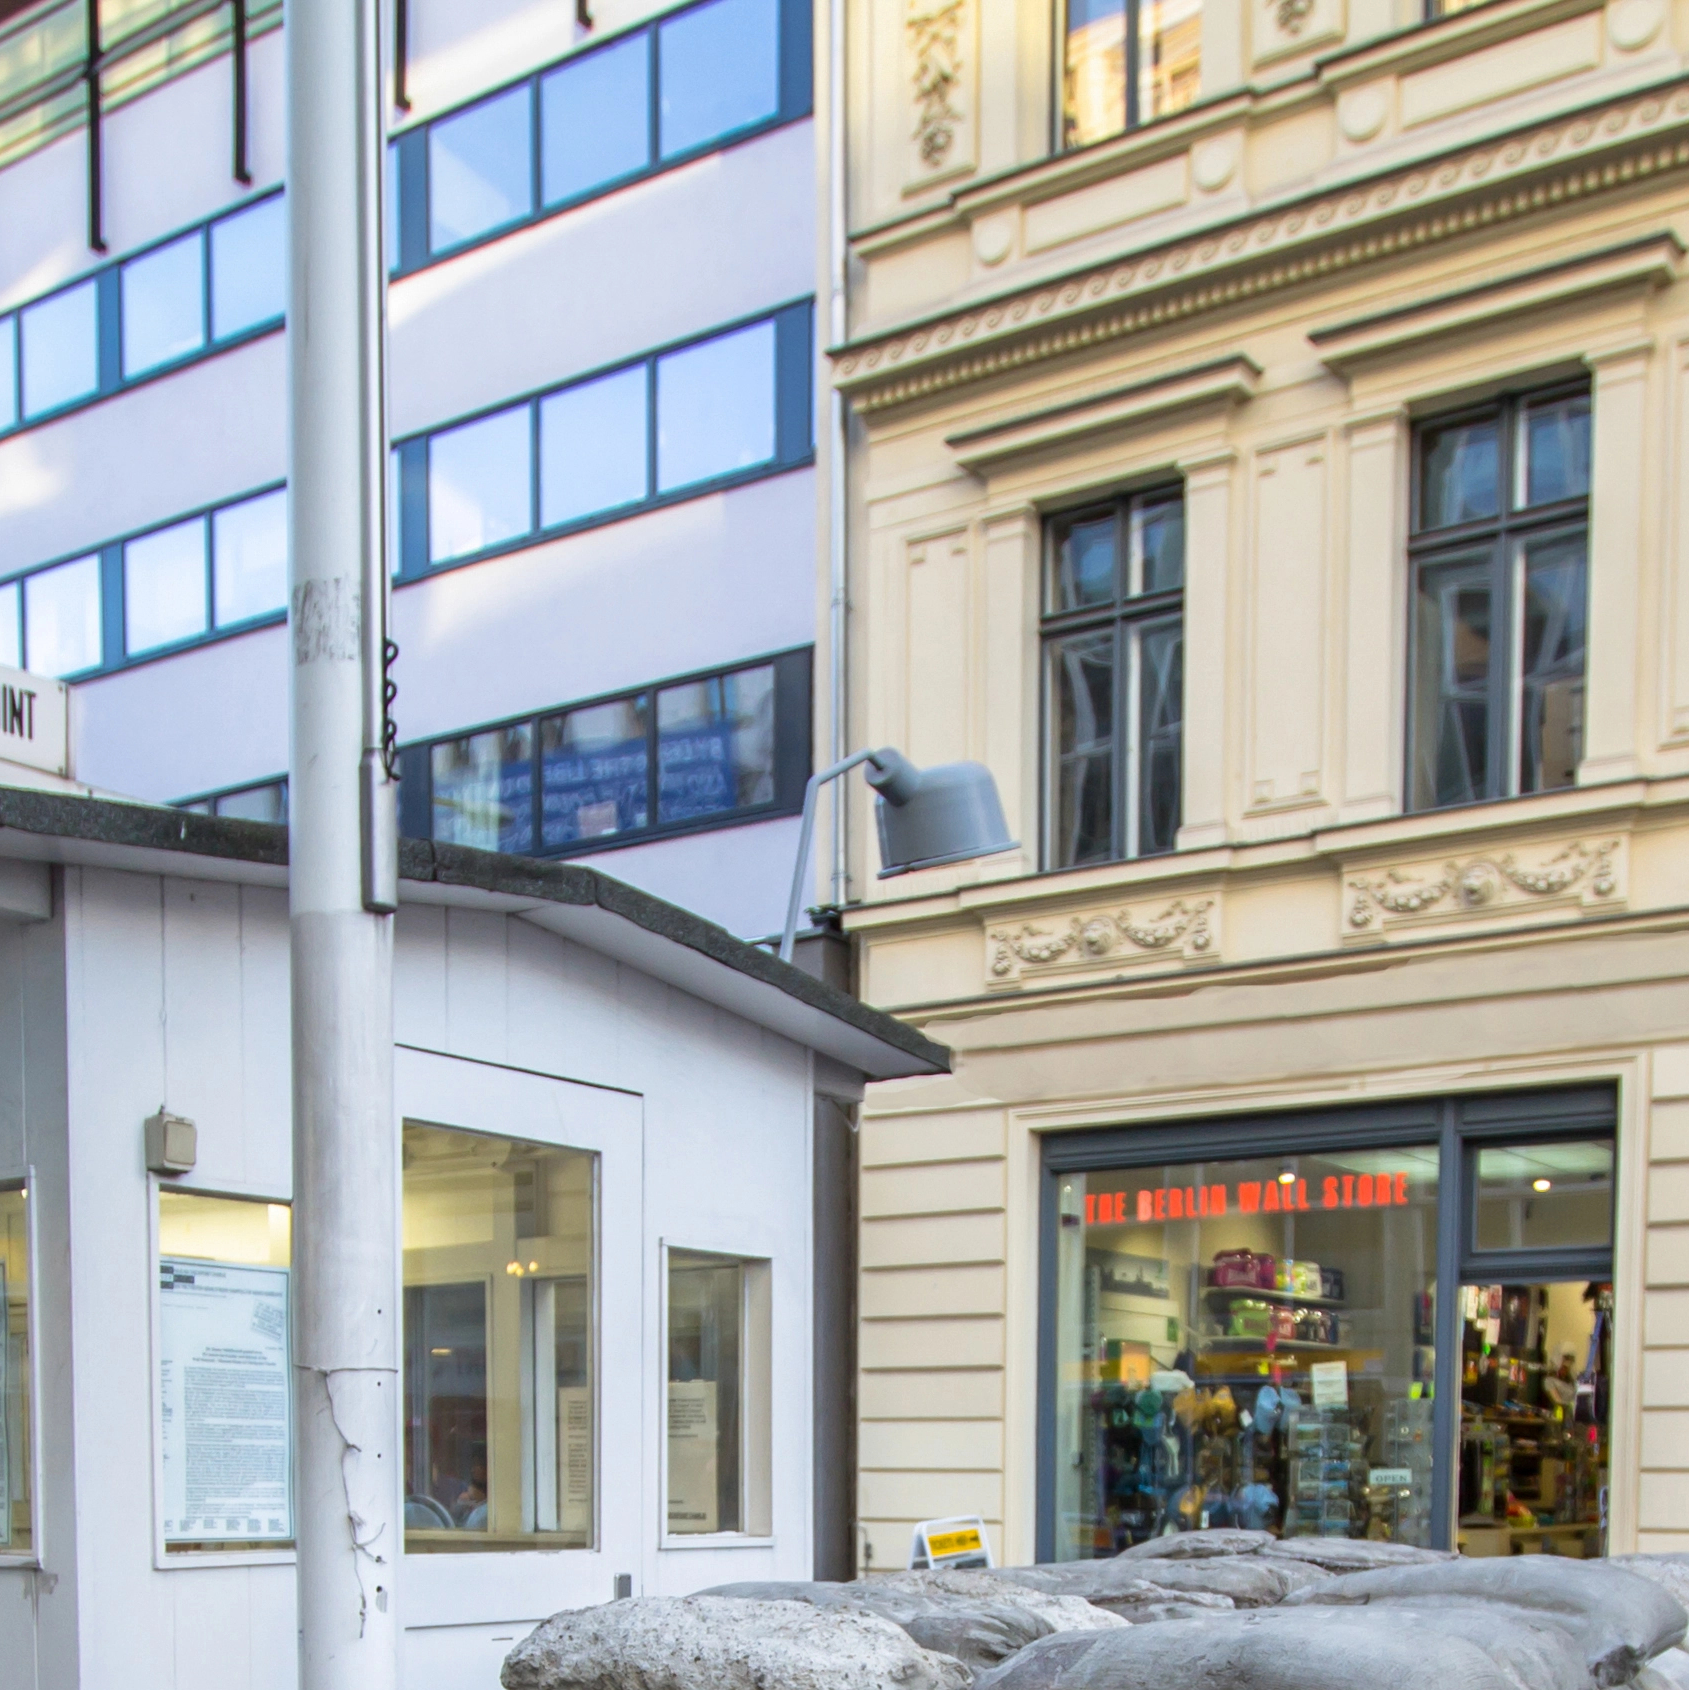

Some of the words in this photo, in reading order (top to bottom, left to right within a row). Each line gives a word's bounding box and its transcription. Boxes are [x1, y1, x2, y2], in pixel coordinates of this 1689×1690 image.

[1086, 1192, 1126, 1225] THE
[1137, 1184, 1227, 1221] BERLIN
[1238, 1178, 1309, 1214] WALL
[1322, 1172, 1408, 1208] STORE
[1374, 1473, 1408, 1483] OPEN
